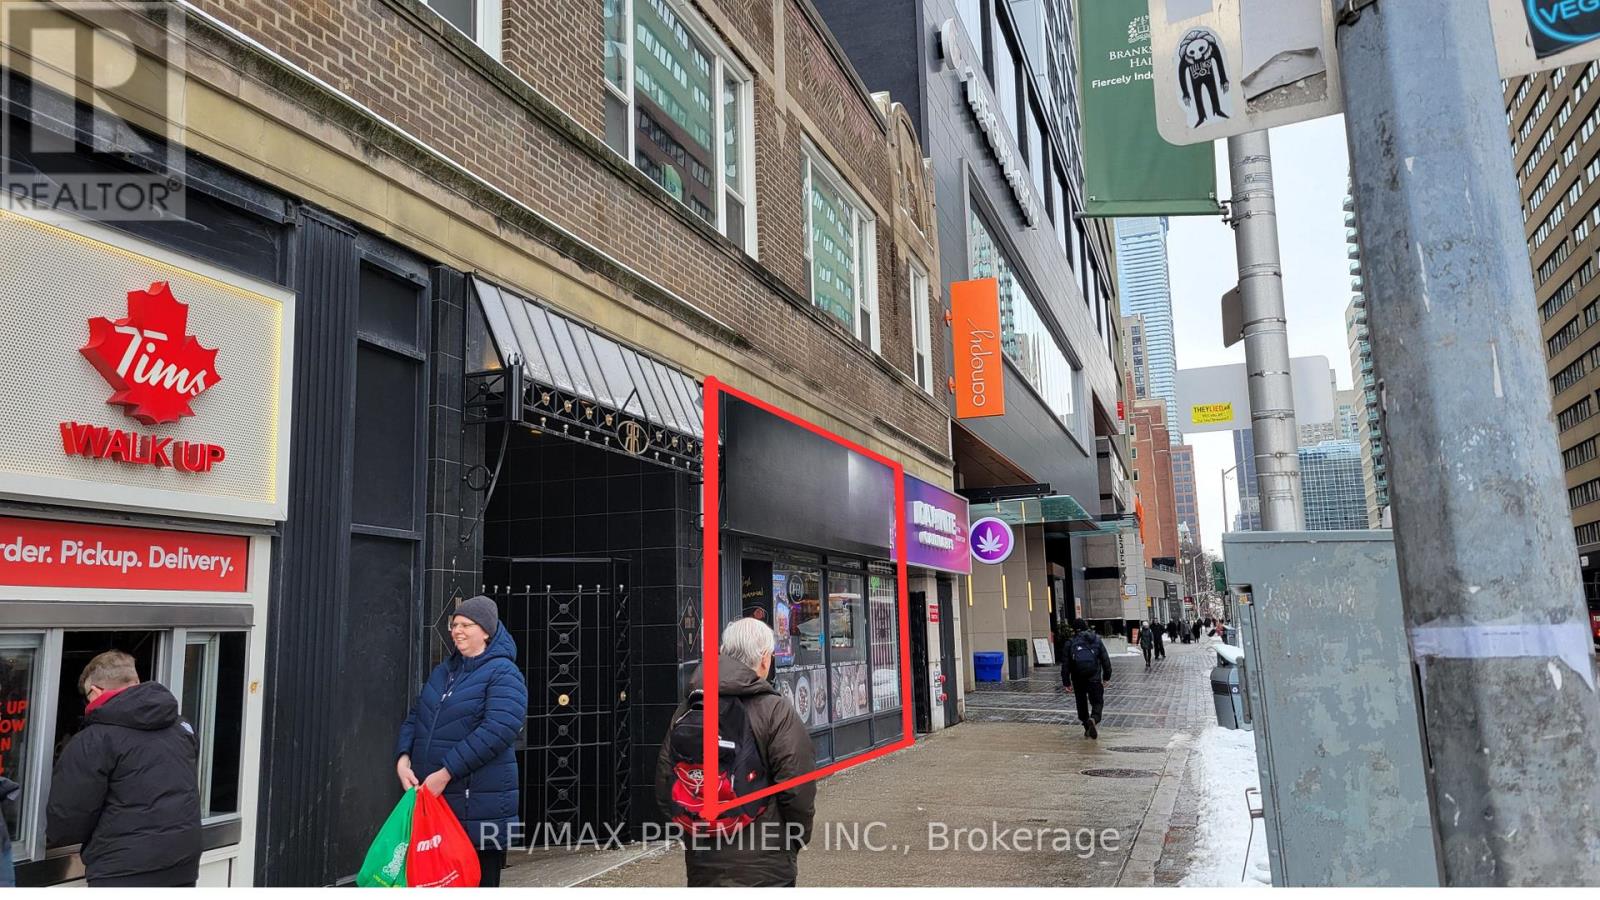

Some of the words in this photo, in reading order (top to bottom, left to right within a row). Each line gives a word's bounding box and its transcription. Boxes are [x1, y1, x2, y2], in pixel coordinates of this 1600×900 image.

[1092, 75, 1131, 88] Fiercely
[114, 325, 207, 396] Tims
[967, 318, 995, 406] canopy
[60, 421, 173, 468] WALK
[173, 441, 226, 473] UP
[60, 539, 142, 574] Pickup.
[149, 546, 234, 578] Delivery.
